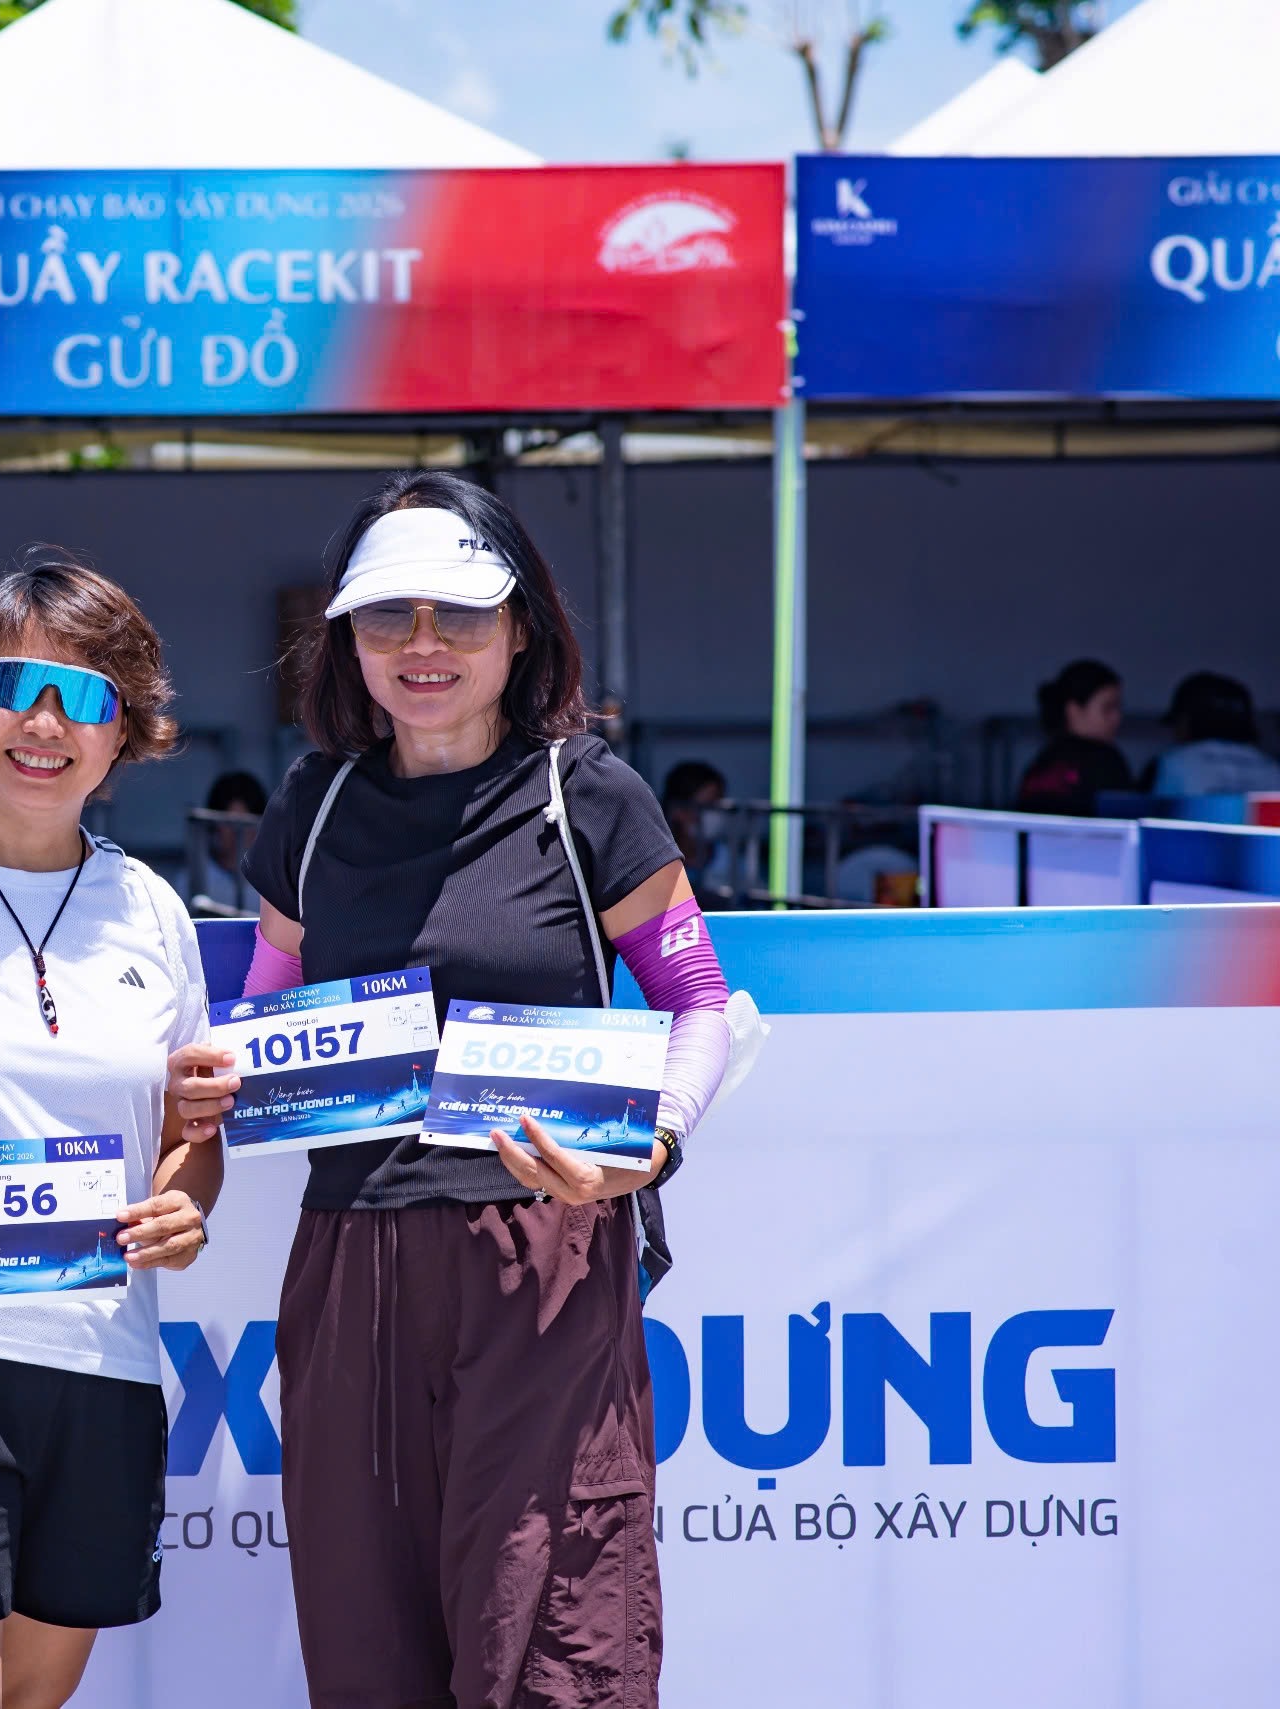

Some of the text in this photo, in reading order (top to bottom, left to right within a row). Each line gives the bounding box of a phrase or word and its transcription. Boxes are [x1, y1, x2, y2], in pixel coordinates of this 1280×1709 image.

[143, 249, 423, 304] RACEKIT
[53, 307, 298, 389] GỬI ĐỒ
[362, 975, 407, 995] 10KM
[323, 995, 341, 1003] 2026
[245, 1021, 365, 1068] 10157
[461, 1040, 603, 1076] 50250
[264, 1104, 289, 1115] TẠO
[336, 1094, 356, 1105] LAI
[471, 1103, 496, 1113] TẠO
[542, 1109, 564, 1119] LAI
[56, 1140, 99, 1156] 10KM
[20, 1256, 40, 1266] LAI
[231, 1510, 289, 1557] QU
[682, 1494, 777, 1542] CỦA
[794, 1493, 856, 1550] BỘ
[873, 1492, 968, 1540] XÂY
[985, 1494, 1119, 1547] DỰNG
